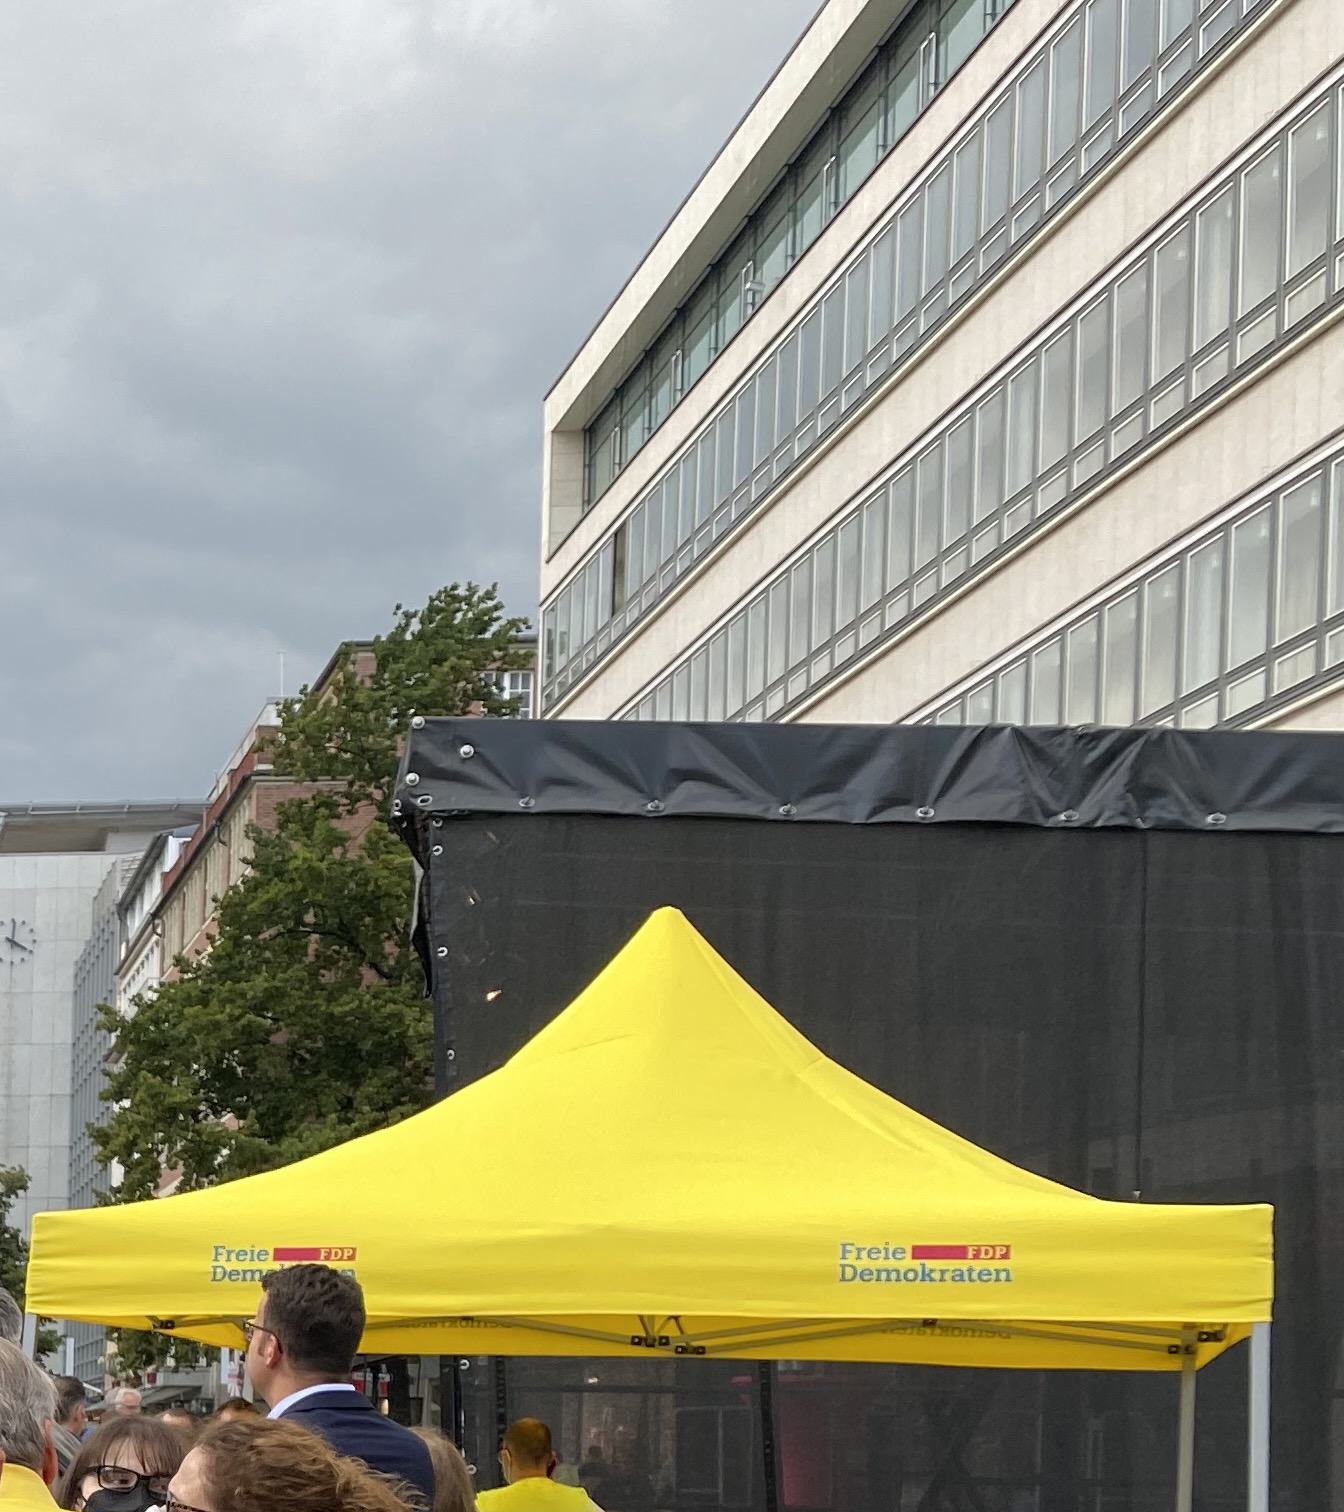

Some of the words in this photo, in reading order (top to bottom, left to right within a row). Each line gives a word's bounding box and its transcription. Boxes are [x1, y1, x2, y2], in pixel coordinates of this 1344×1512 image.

[212, 1244, 270, 1262] Freie
[320, 1248, 354, 1260] FDP
[839, 1241, 907, 1261] Freie
[967, 1246, 1008, 1259] FDP
[839, 1262, 1013, 1283] Demokraten
